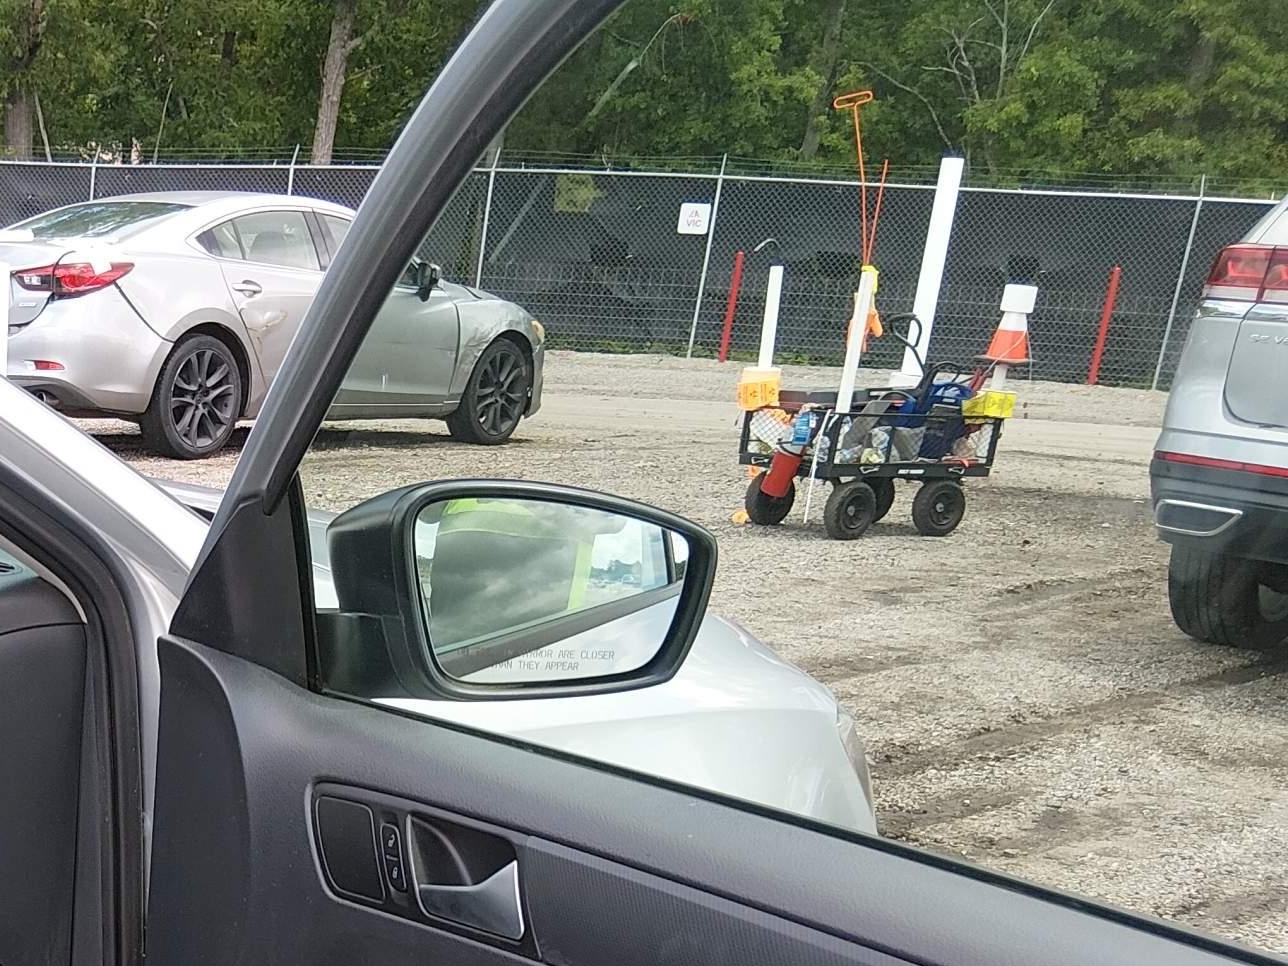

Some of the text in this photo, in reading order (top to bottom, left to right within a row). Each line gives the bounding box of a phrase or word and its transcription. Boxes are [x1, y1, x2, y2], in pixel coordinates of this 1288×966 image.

[558, 650, 577, 660] ARE
[580, 650, 616, 660] CLOSER
[519, 660, 541, 671] THEY
[545, 661, 580, 671] APPEAR
